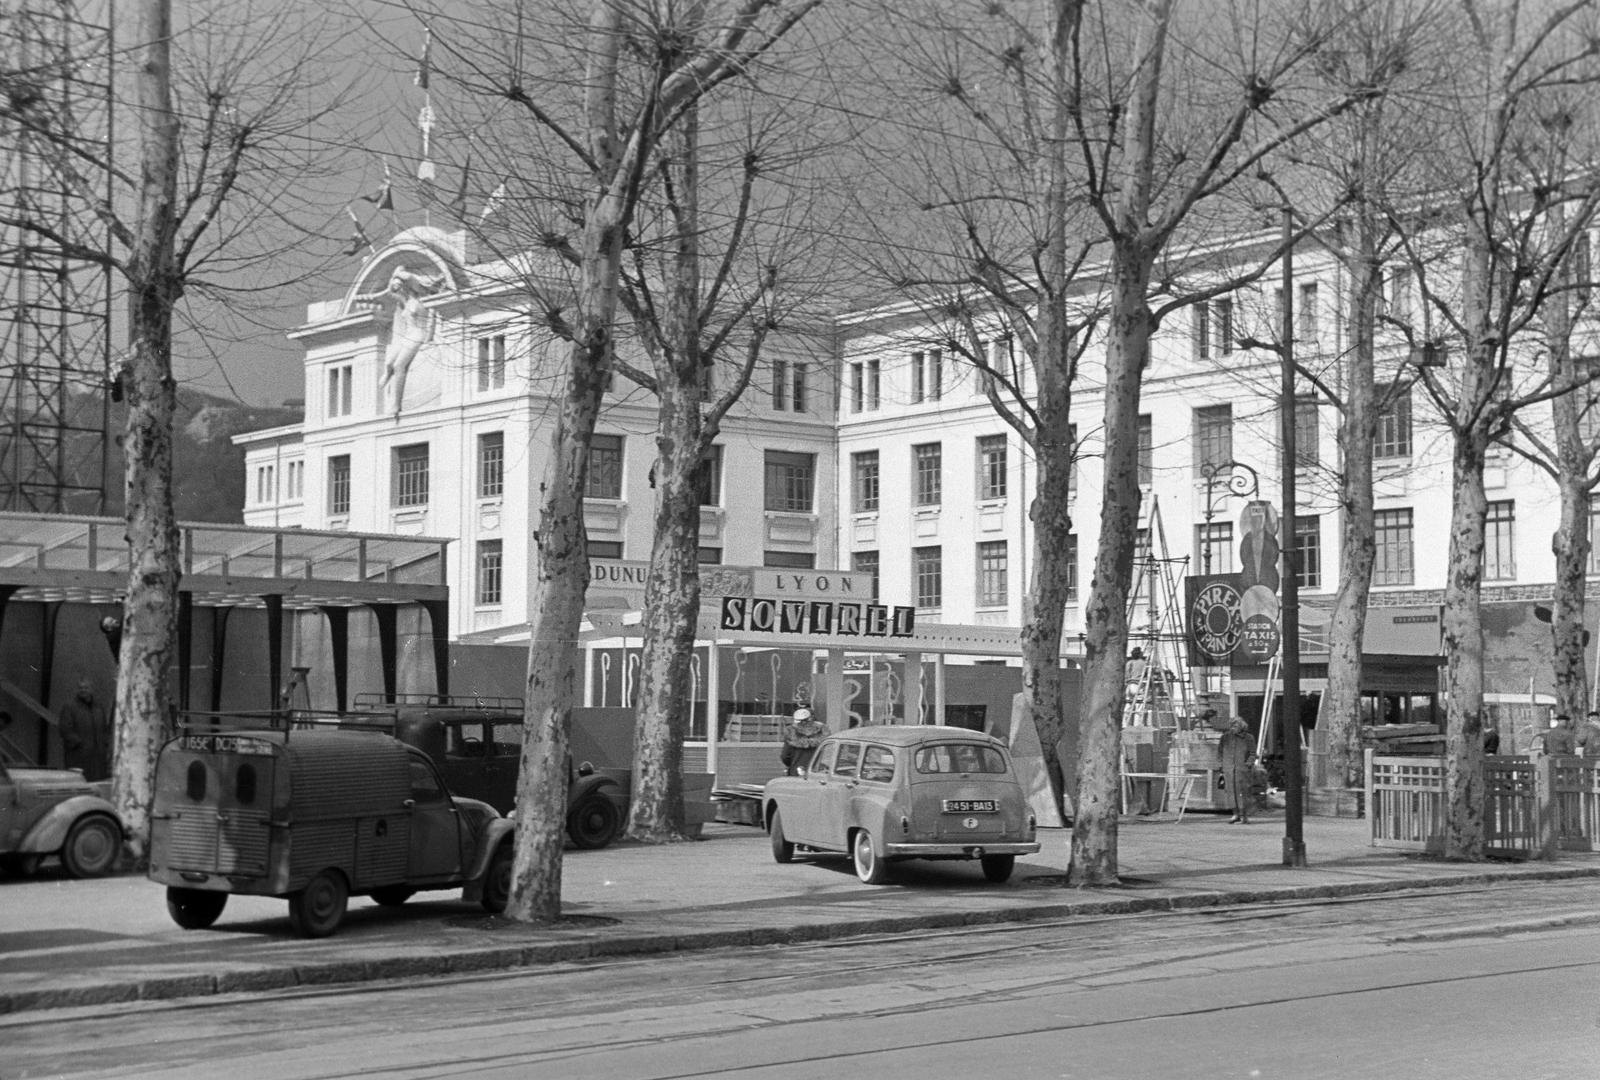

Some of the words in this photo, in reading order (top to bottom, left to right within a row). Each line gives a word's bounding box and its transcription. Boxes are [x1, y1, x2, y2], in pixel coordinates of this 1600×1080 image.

[595, 565, 647, 583] DUNU
[776, 575, 852, 592] LYON
[1196, 587, 1241, 616] PYREX
[725, 598, 915, 636] SOVIREL
[1196, 624, 1241, 652] FRANCE
[1243, 631, 1276, 640] TAXIS
